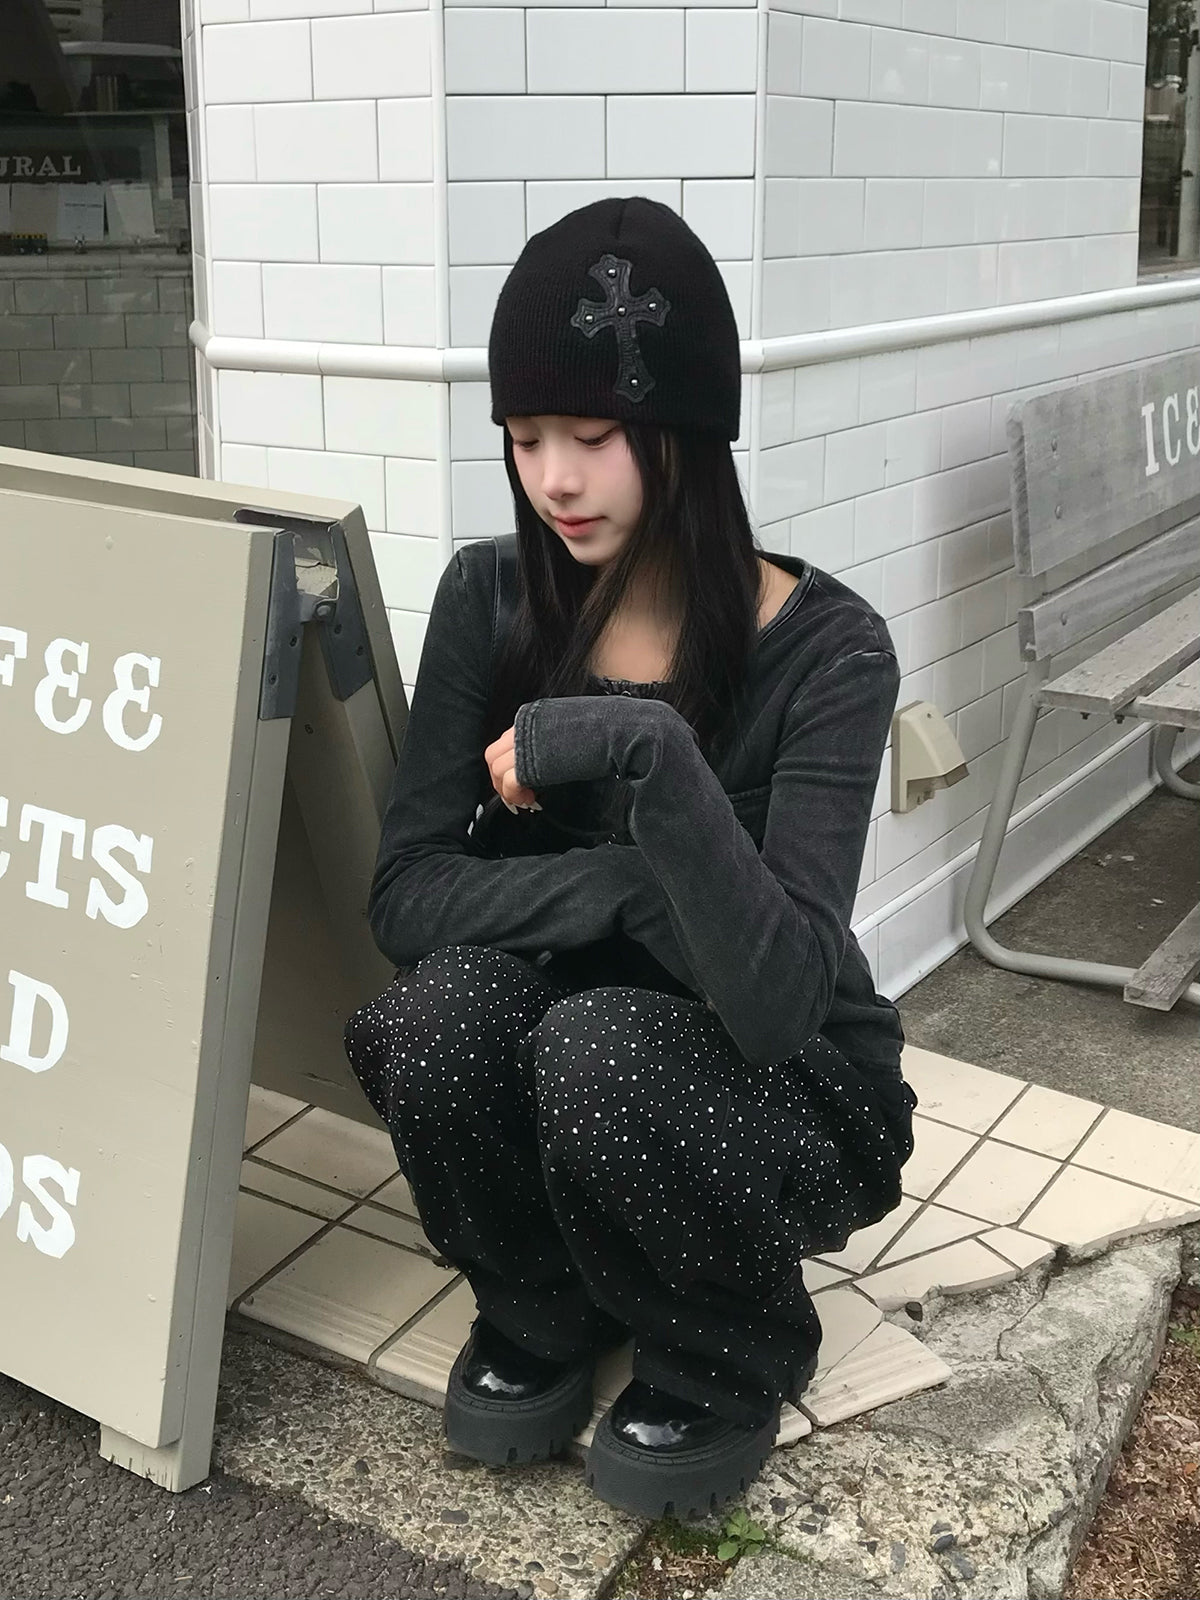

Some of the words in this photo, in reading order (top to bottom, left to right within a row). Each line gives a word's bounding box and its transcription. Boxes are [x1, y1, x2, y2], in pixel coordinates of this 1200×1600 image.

[1141, 386, 1200, 476] ICE
[0, 796, 154, 929] TS
[0, 1143, 81, 1259] S
